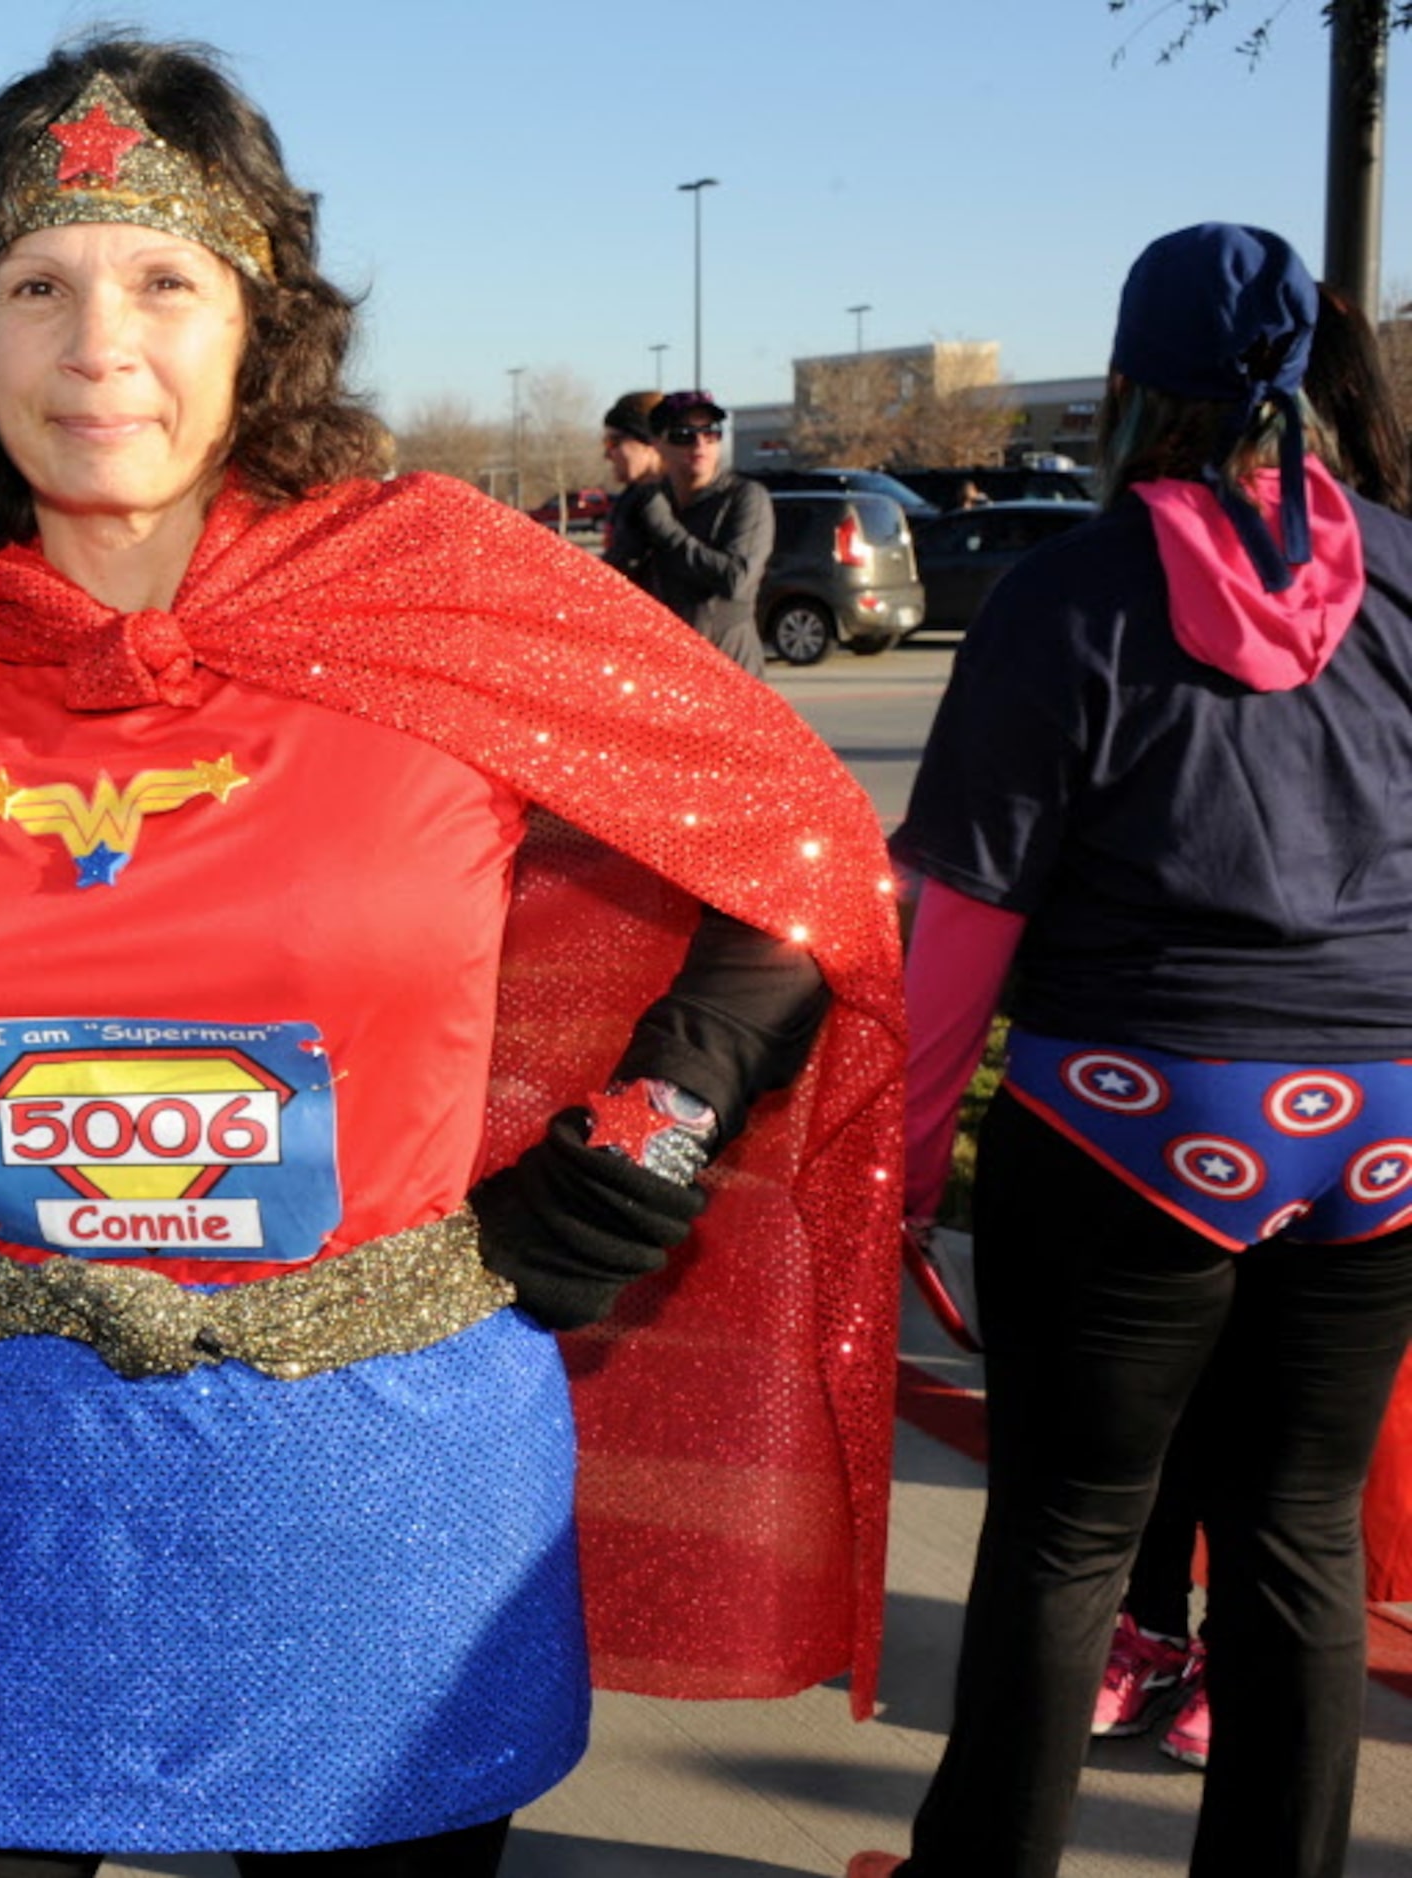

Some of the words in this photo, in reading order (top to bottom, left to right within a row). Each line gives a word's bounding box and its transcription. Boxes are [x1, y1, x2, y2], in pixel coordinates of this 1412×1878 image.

[22, 1029, 70, 1044] am
[8, 1095, 269, 1160] 5006
[68, 1206, 232, 1241] Connie
